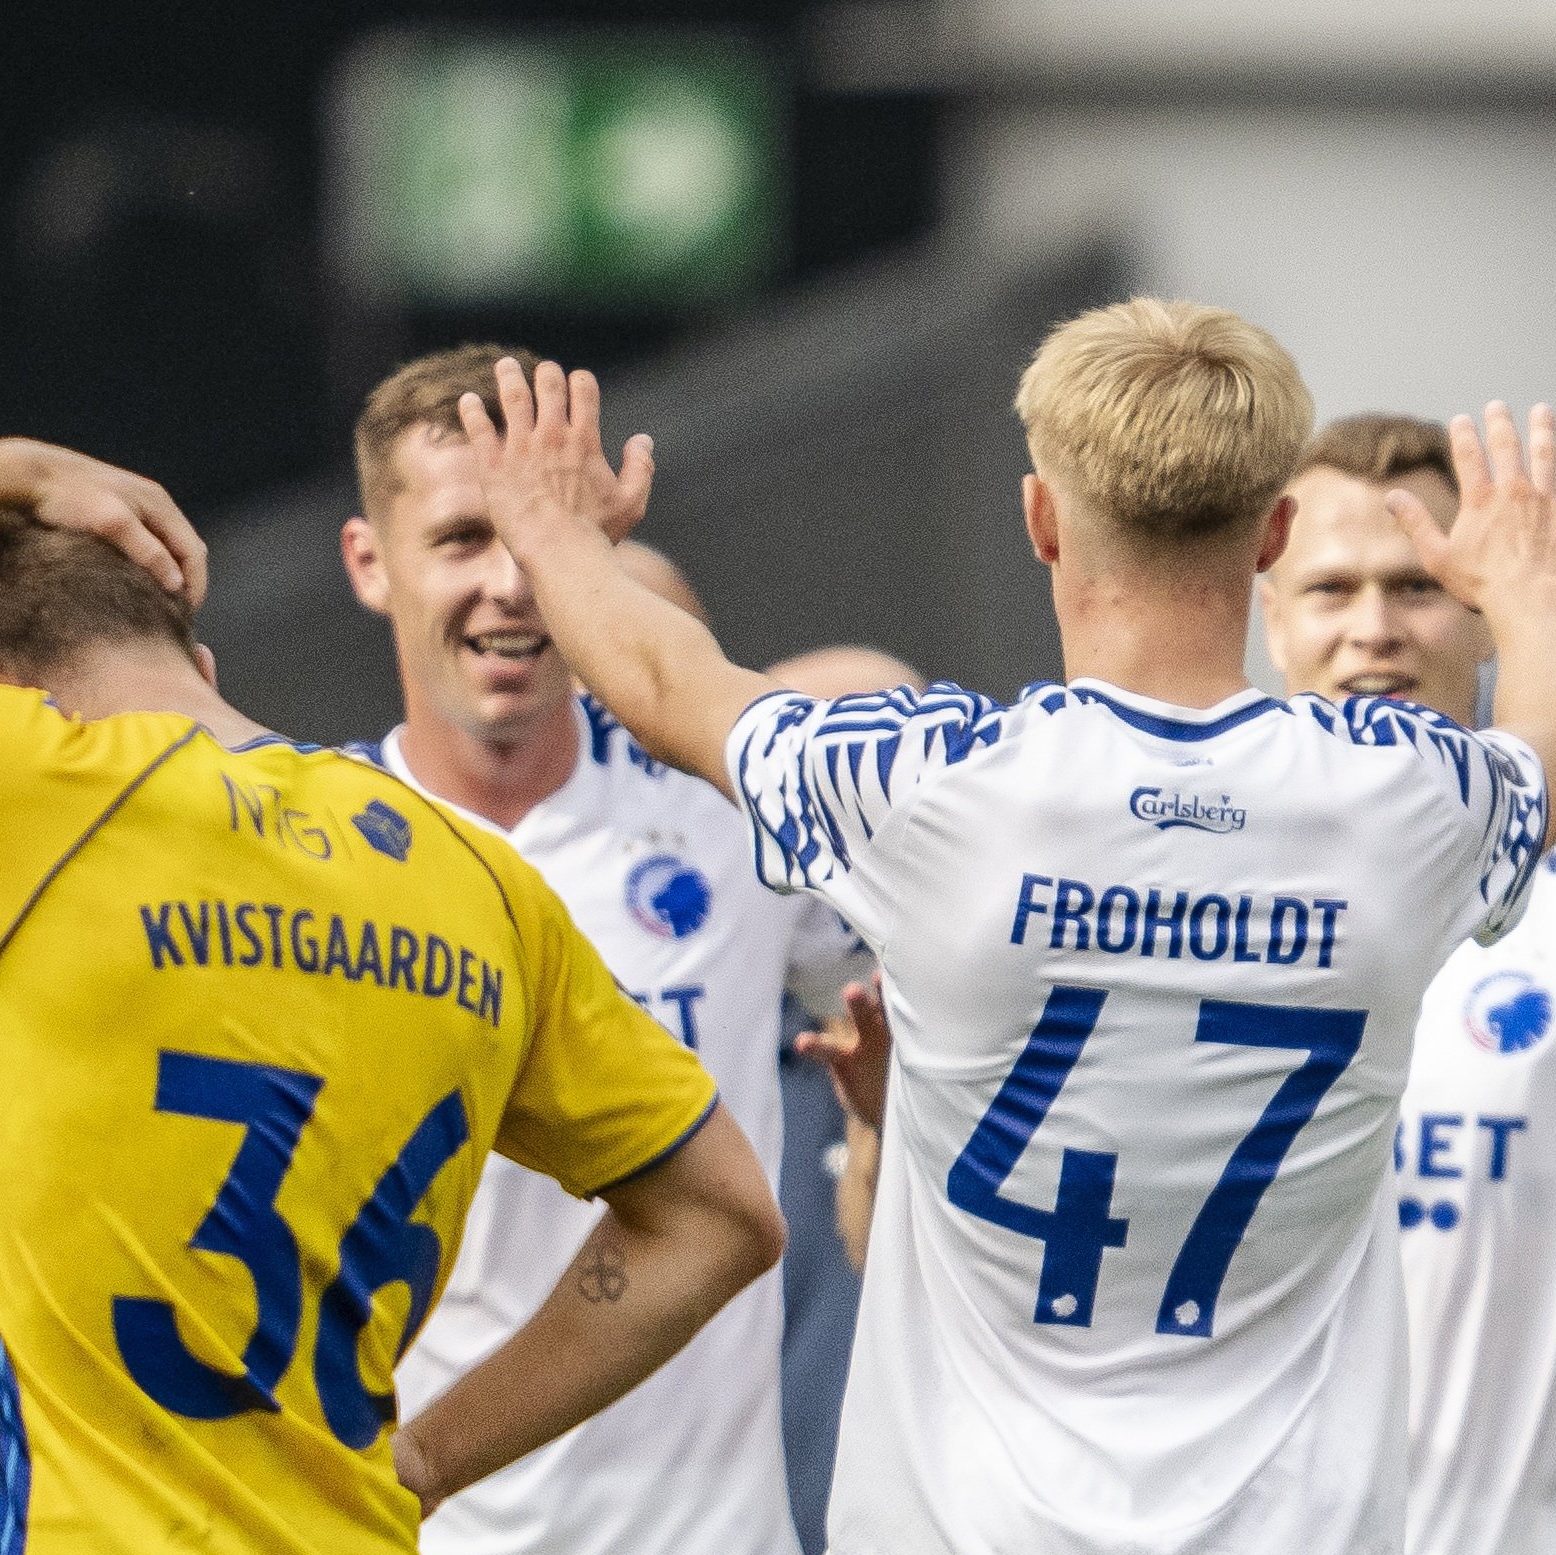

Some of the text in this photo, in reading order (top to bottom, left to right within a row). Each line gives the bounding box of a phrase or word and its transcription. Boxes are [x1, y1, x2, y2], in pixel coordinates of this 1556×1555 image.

[1129, 786, 1247, 834] Carlsberg
[140, 900, 505, 1029] KVISTGAARDEN
[1010, 872, 1348, 968] FROHOLDT
[947, 985, 1369, 1337] 47
[1394, 1113, 1529, 1182] ET
[111, 1048, 470, 1450] 36
